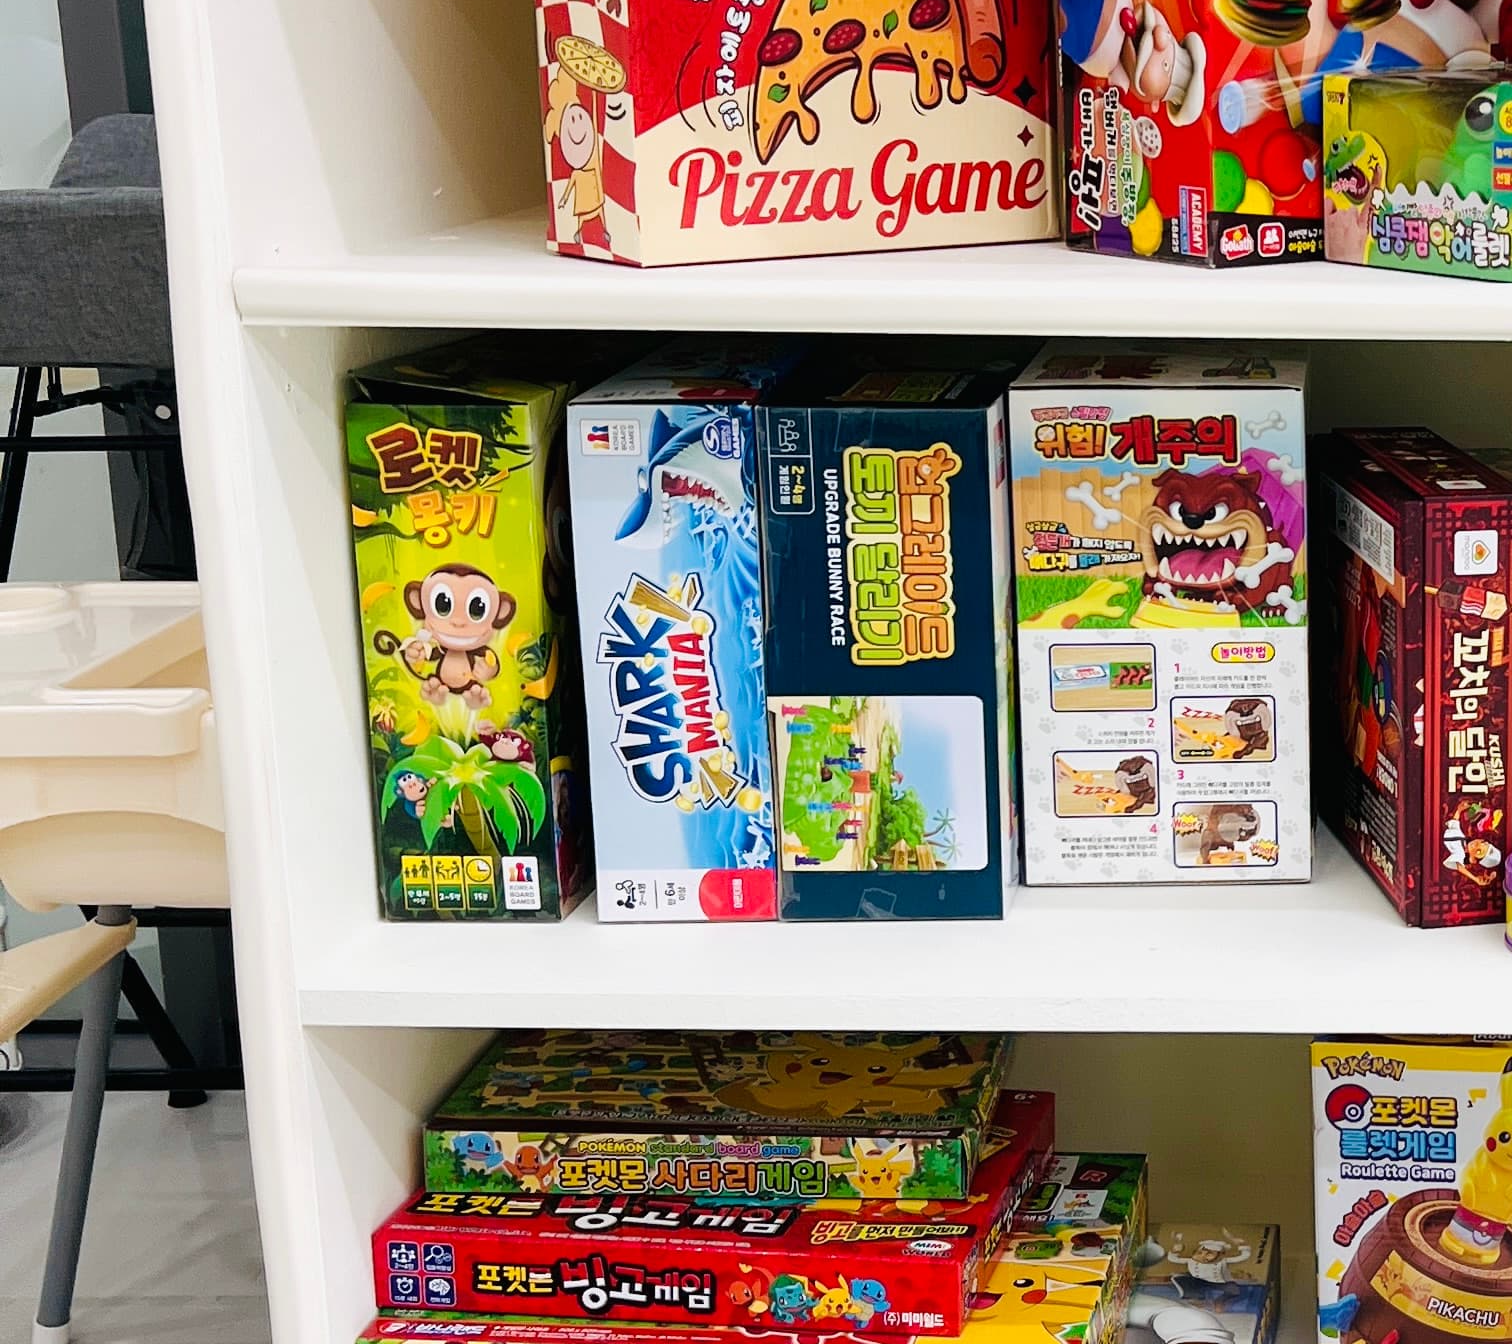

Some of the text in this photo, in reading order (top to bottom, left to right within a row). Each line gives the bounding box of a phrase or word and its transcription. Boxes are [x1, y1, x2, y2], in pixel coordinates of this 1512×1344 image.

[668, 138, 1049, 238] Pizza Game
[1069, 153, 1103, 230] 펑!
[1191, 192, 1203, 250] ACADEMY
[366, 422, 483, 494] 로켓
[1035, 414, 1238, 465] 위험! 개주의
[407, 493, 499, 547] 몽키
[823, 468, 846, 647] UPGRADE BUNNY RACE
[849, 451, 905, 662] 토끼 달리기
[897, 446, 956, 659] 업그레이드
[1174, 663, 1180, 673] 1
[1220, 646, 1266, 659] 놀이방법
[597, 600, 694, 803] SHARK
[685, 631, 721, 754] MANIA
[1448, 628, 1491, 796] 꼬치의 달인
[1147, 717, 1155, 728] 2
[1176, 769, 1185, 780] 3
[1487, 733, 1506, 787] KUSHI
[1149, 823, 1158, 834] 4
[1371, 1096, 1459, 1130] 포켓몬
[579, 1138, 646, 1154] POKÉMON
[717, 1141, 760, 1156] board
[762, 1143, 800, 1158] game
[1340, 1128, 1457, 1163] 룰렛게임
[558, 1158, 828, 1196] 포켓몬 사다리게임
[1340, 1163, 1456, 1183] Roulette Game
[417, 1193, 544, 1216] 포켓몬
[477, 1257, 713, 1311] 포켓몬 빙고게임
[1426, 1297, 1500, 1326] PIKACHU
